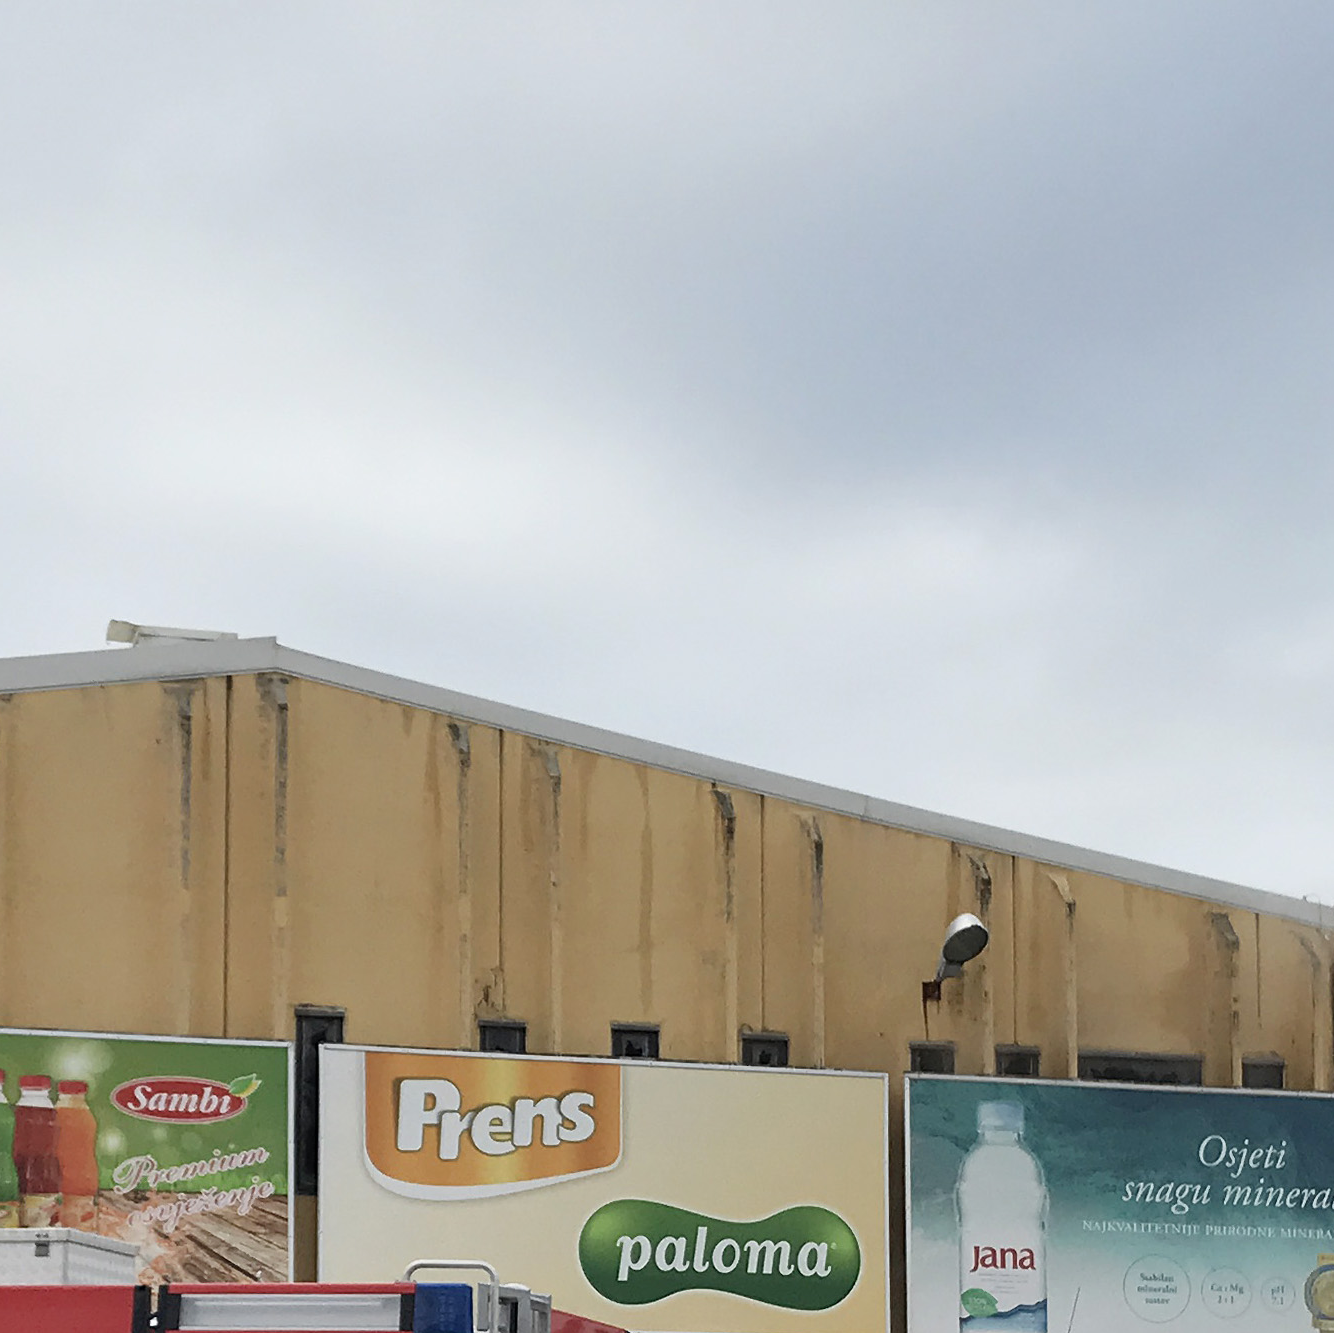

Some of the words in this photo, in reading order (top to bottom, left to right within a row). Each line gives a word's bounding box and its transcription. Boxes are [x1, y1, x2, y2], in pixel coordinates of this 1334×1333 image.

[127, 1085, 231, 1113] Sambi
[397, 1078, 595, 1160] Prens
[113, 1147, 270, 1194] Premium
[1199, 1135, 1286, 1178] Osjeti
[1122, 1180, 1211, 1214] snagu
[1082, 1219, 1200, 1236] NAJKVALITETNIJE
[1205, 1223, 1276, 1239] PRIRODNE
[616, 1227, 831, 1281] paloma
